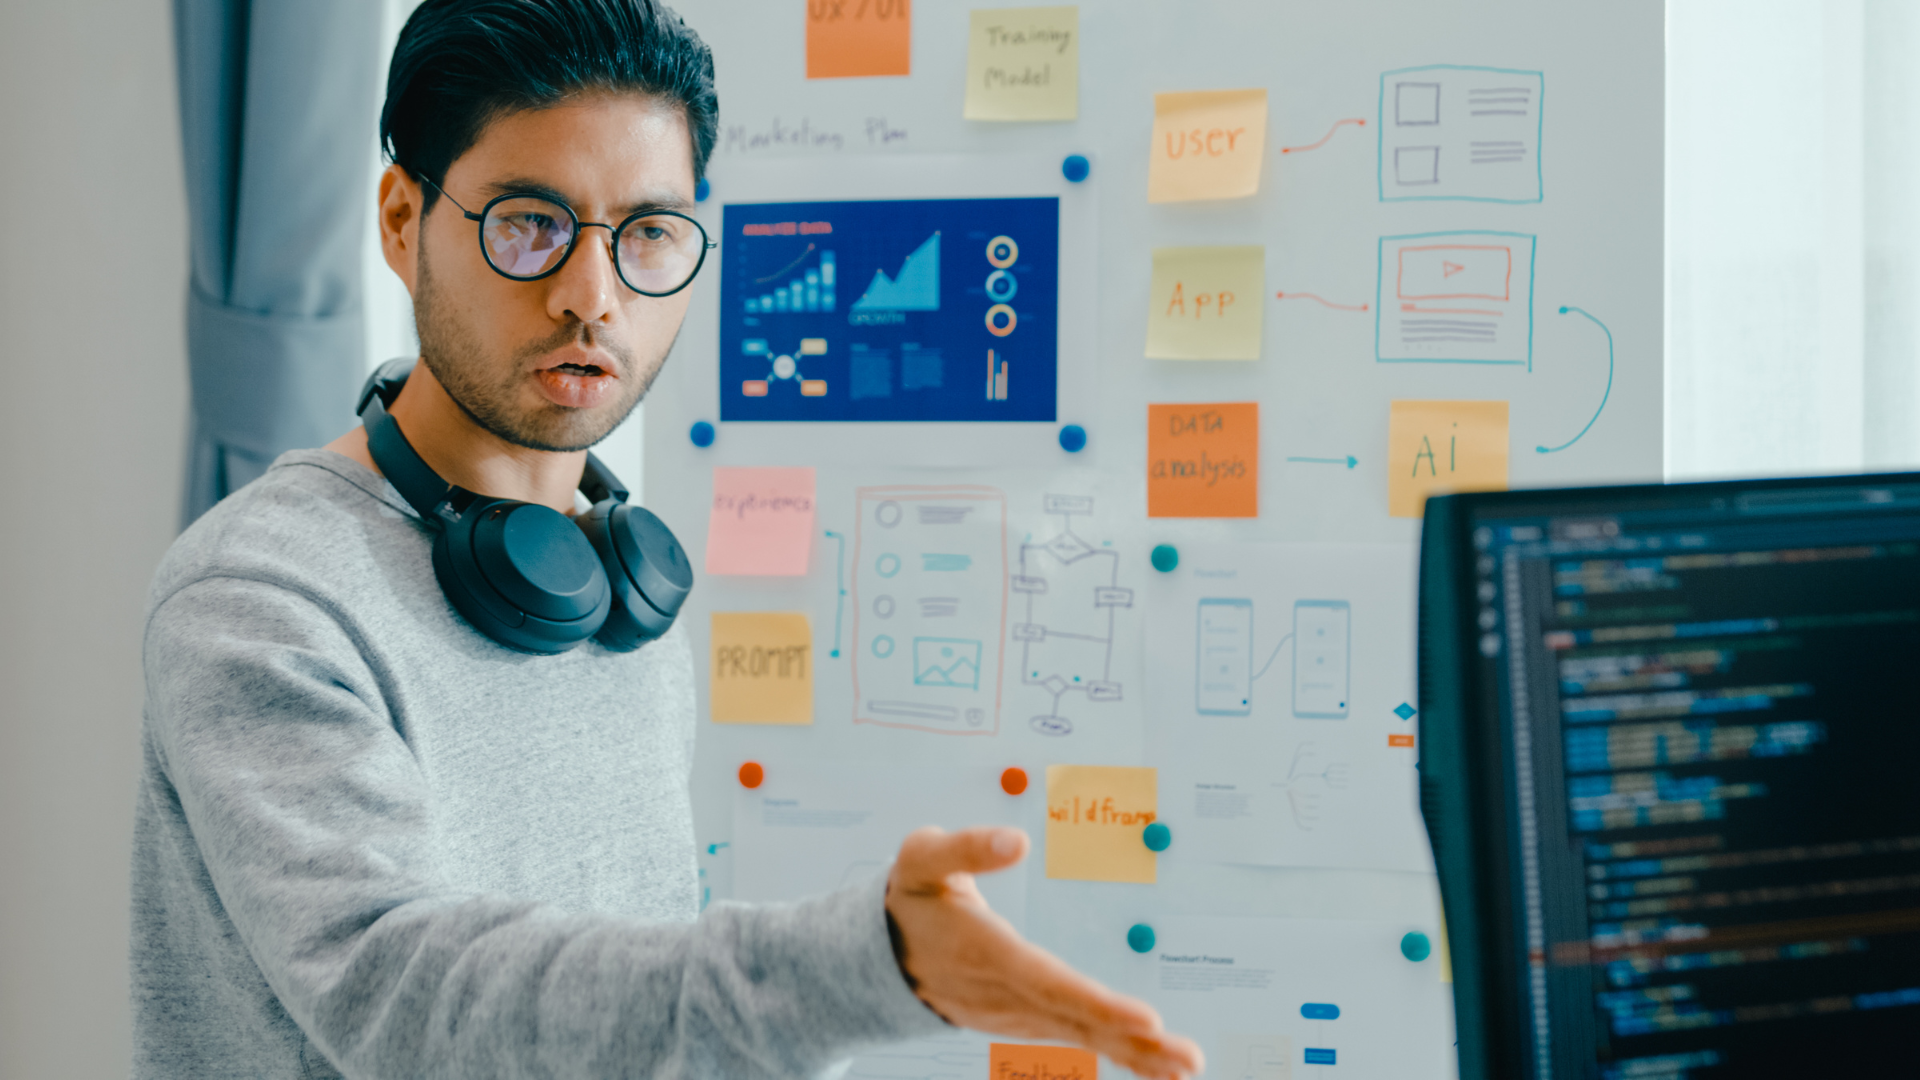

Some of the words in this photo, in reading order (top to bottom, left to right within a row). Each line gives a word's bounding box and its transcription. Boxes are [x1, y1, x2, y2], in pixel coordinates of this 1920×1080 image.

[985, 25, 1070, 55] Training
[984, 62, 1051, 89] Model
[725, 117, 843, 152] Marketing
[1165, 281, 1235, 319] App
[1170, 411, 1222, 436] DATA
[1151, 450, 1247, 487] analysis
[717, 644, 810, 680] PROMPT
